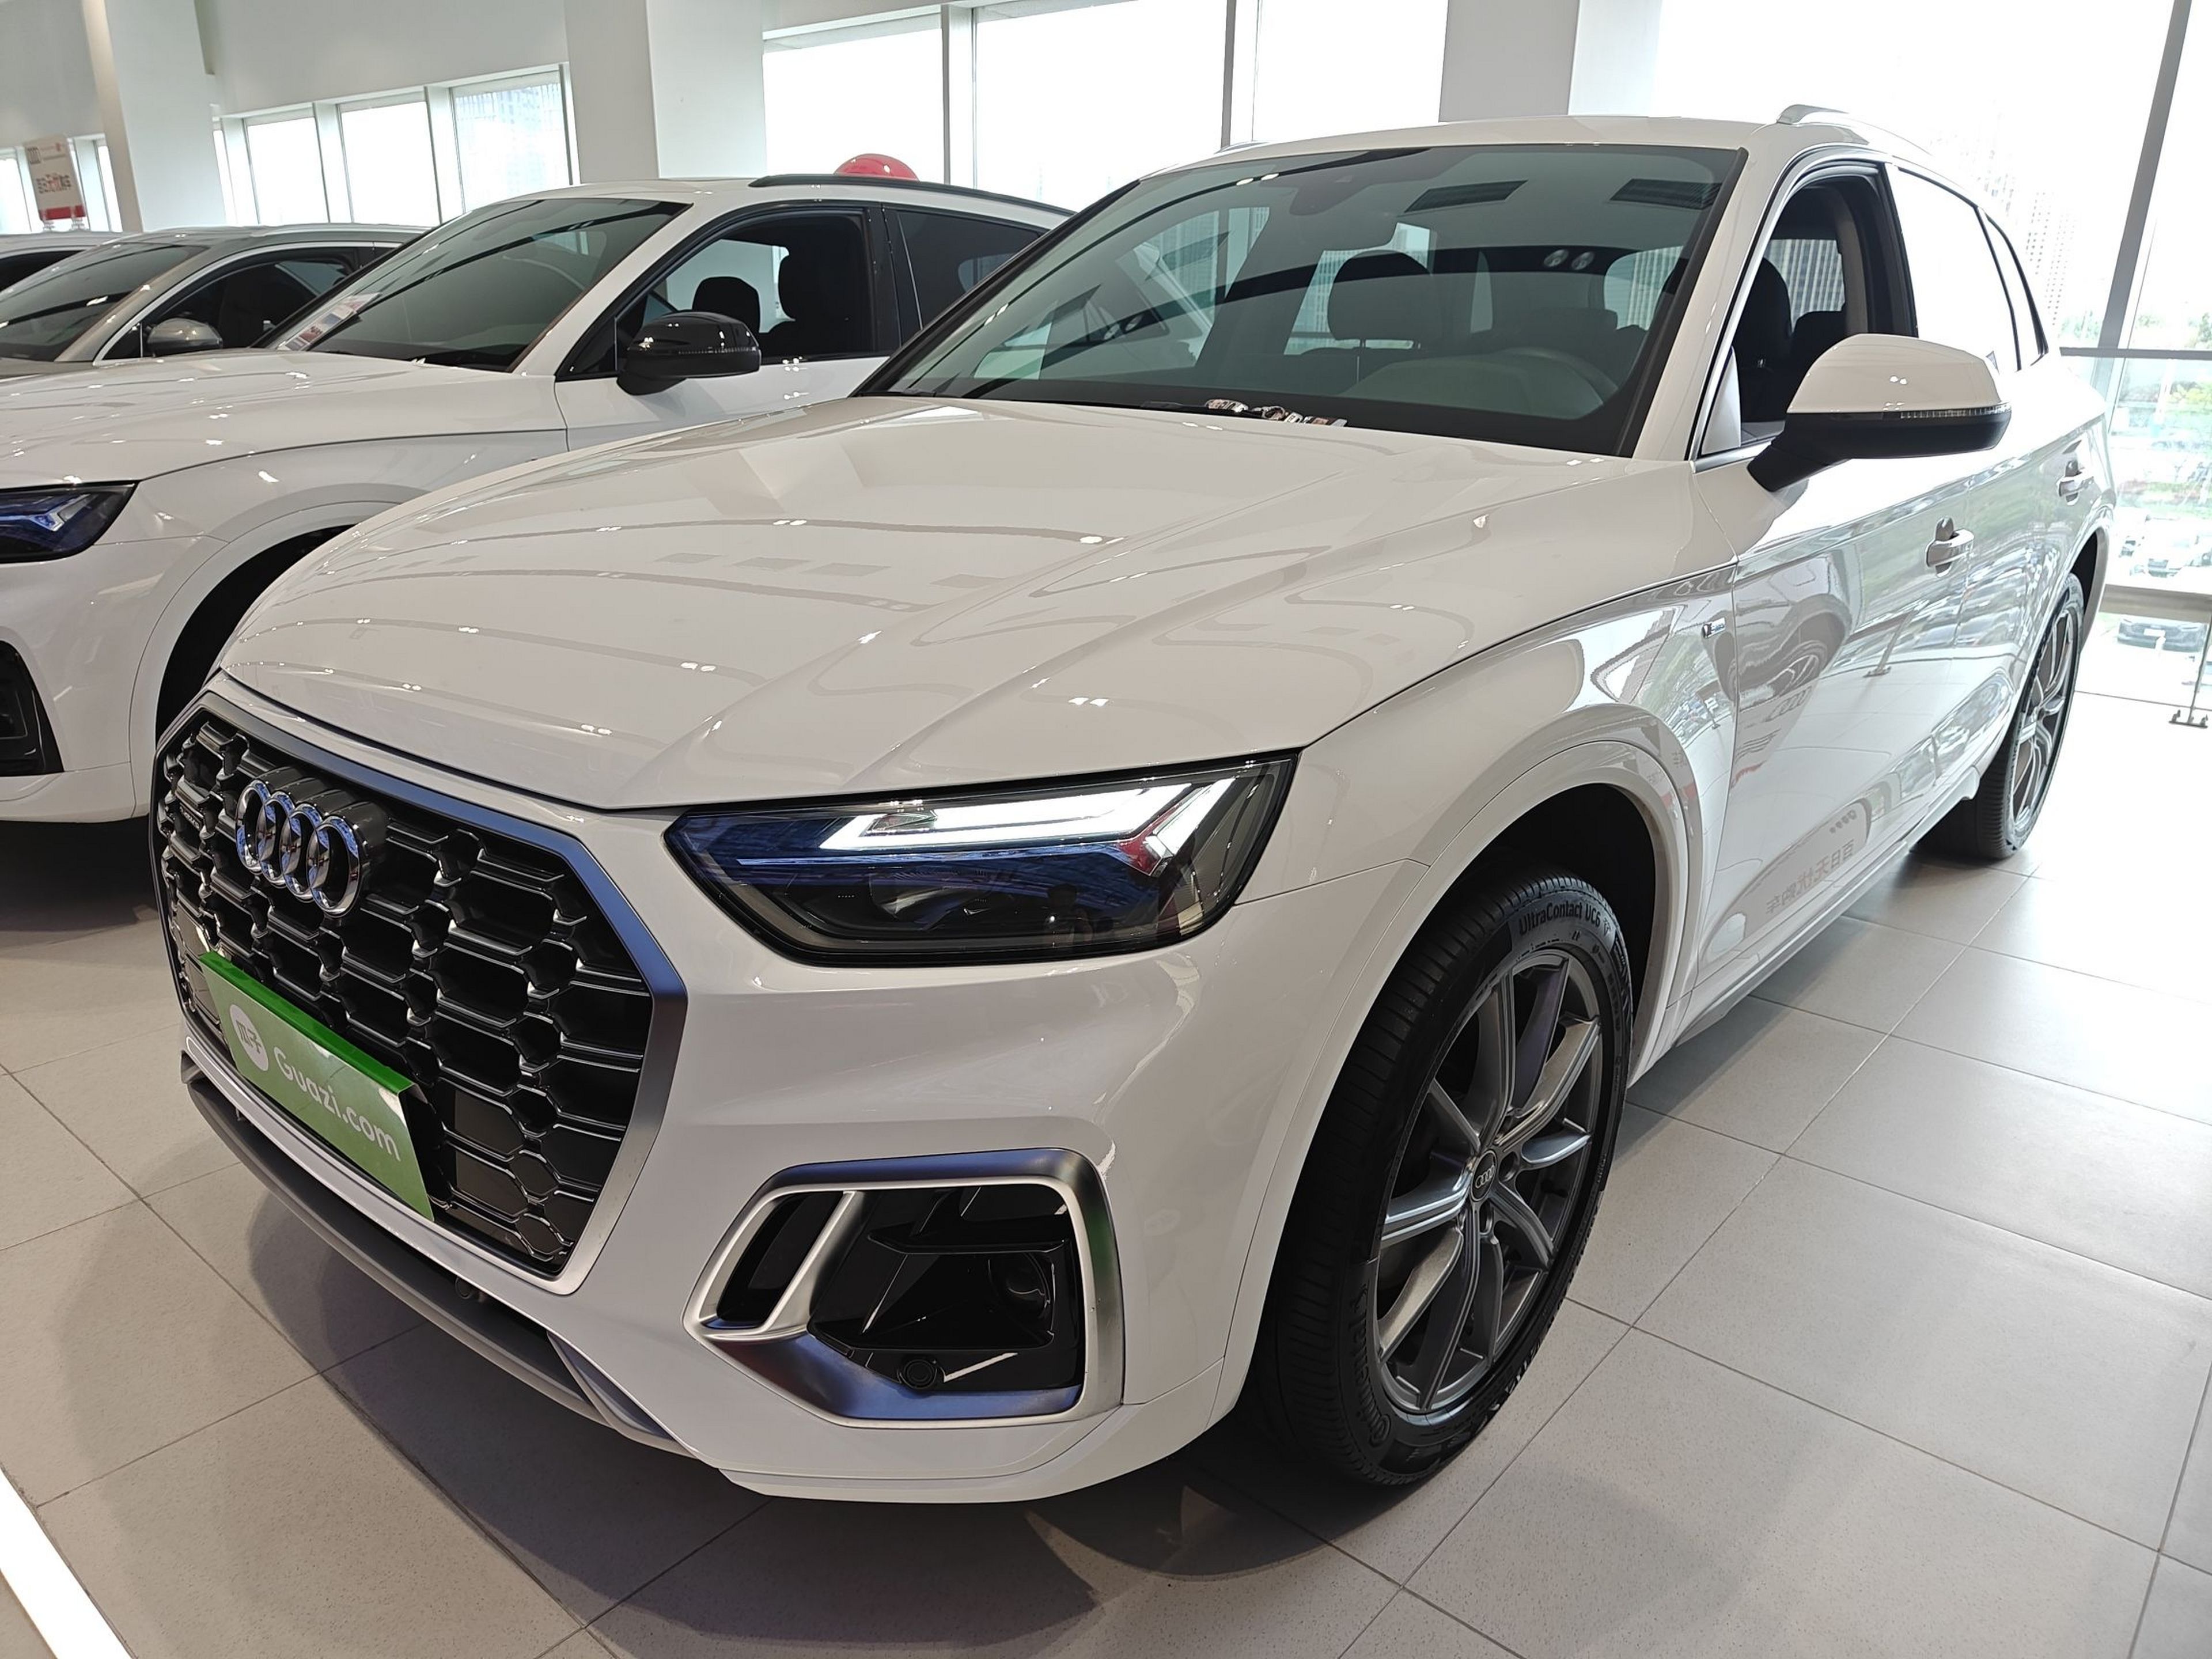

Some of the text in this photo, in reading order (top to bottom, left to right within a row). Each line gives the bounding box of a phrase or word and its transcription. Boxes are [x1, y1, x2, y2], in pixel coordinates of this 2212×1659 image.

[1520, 901, 1601, 935] UltraContact UC6
[274, 1047, 402, 1162] Guazi.com
